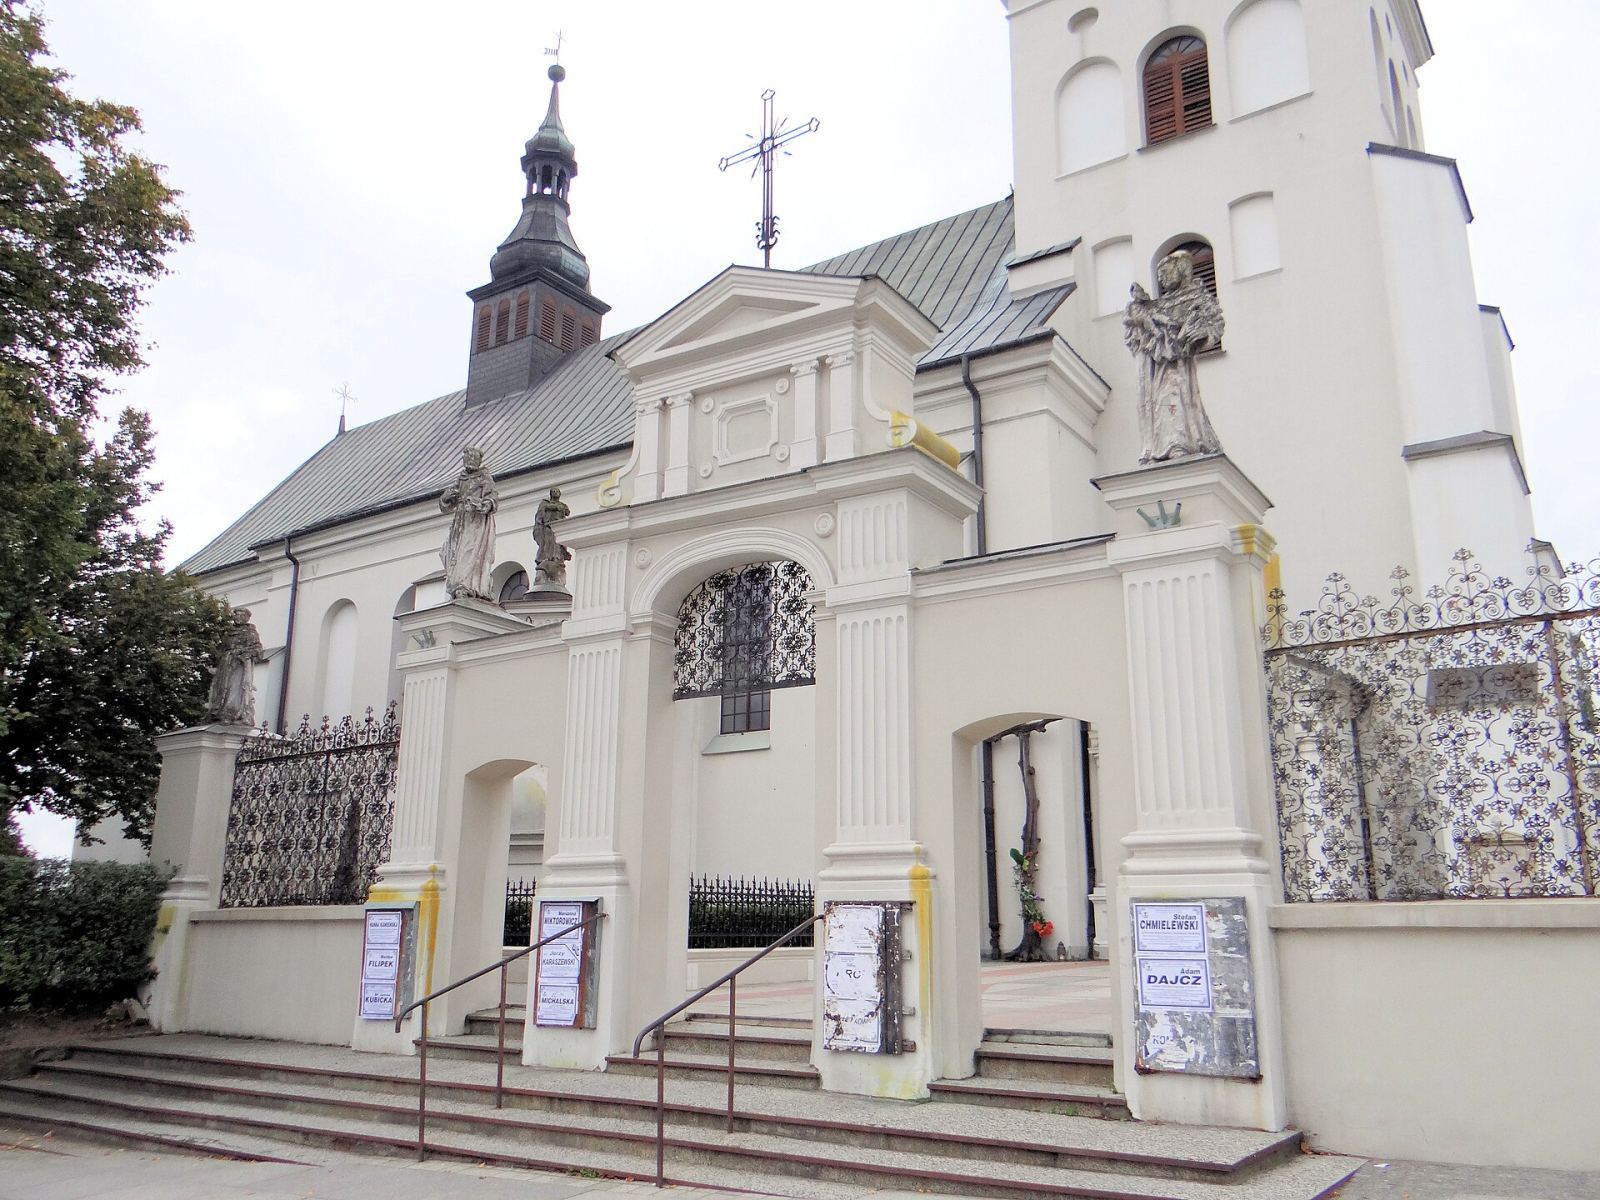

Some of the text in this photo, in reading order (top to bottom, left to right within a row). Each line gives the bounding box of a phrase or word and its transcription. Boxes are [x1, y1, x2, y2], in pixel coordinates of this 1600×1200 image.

[1173, 913, 1197, 921] Stefan
[1139, 919, 1199, 930] CHMIELEWSKI
[1146, 974, 1202, 986] DAJCZ
[365, 996, 392, 1004] KUBICKA
[541, 997, 574, 1005] MICHALSKA
